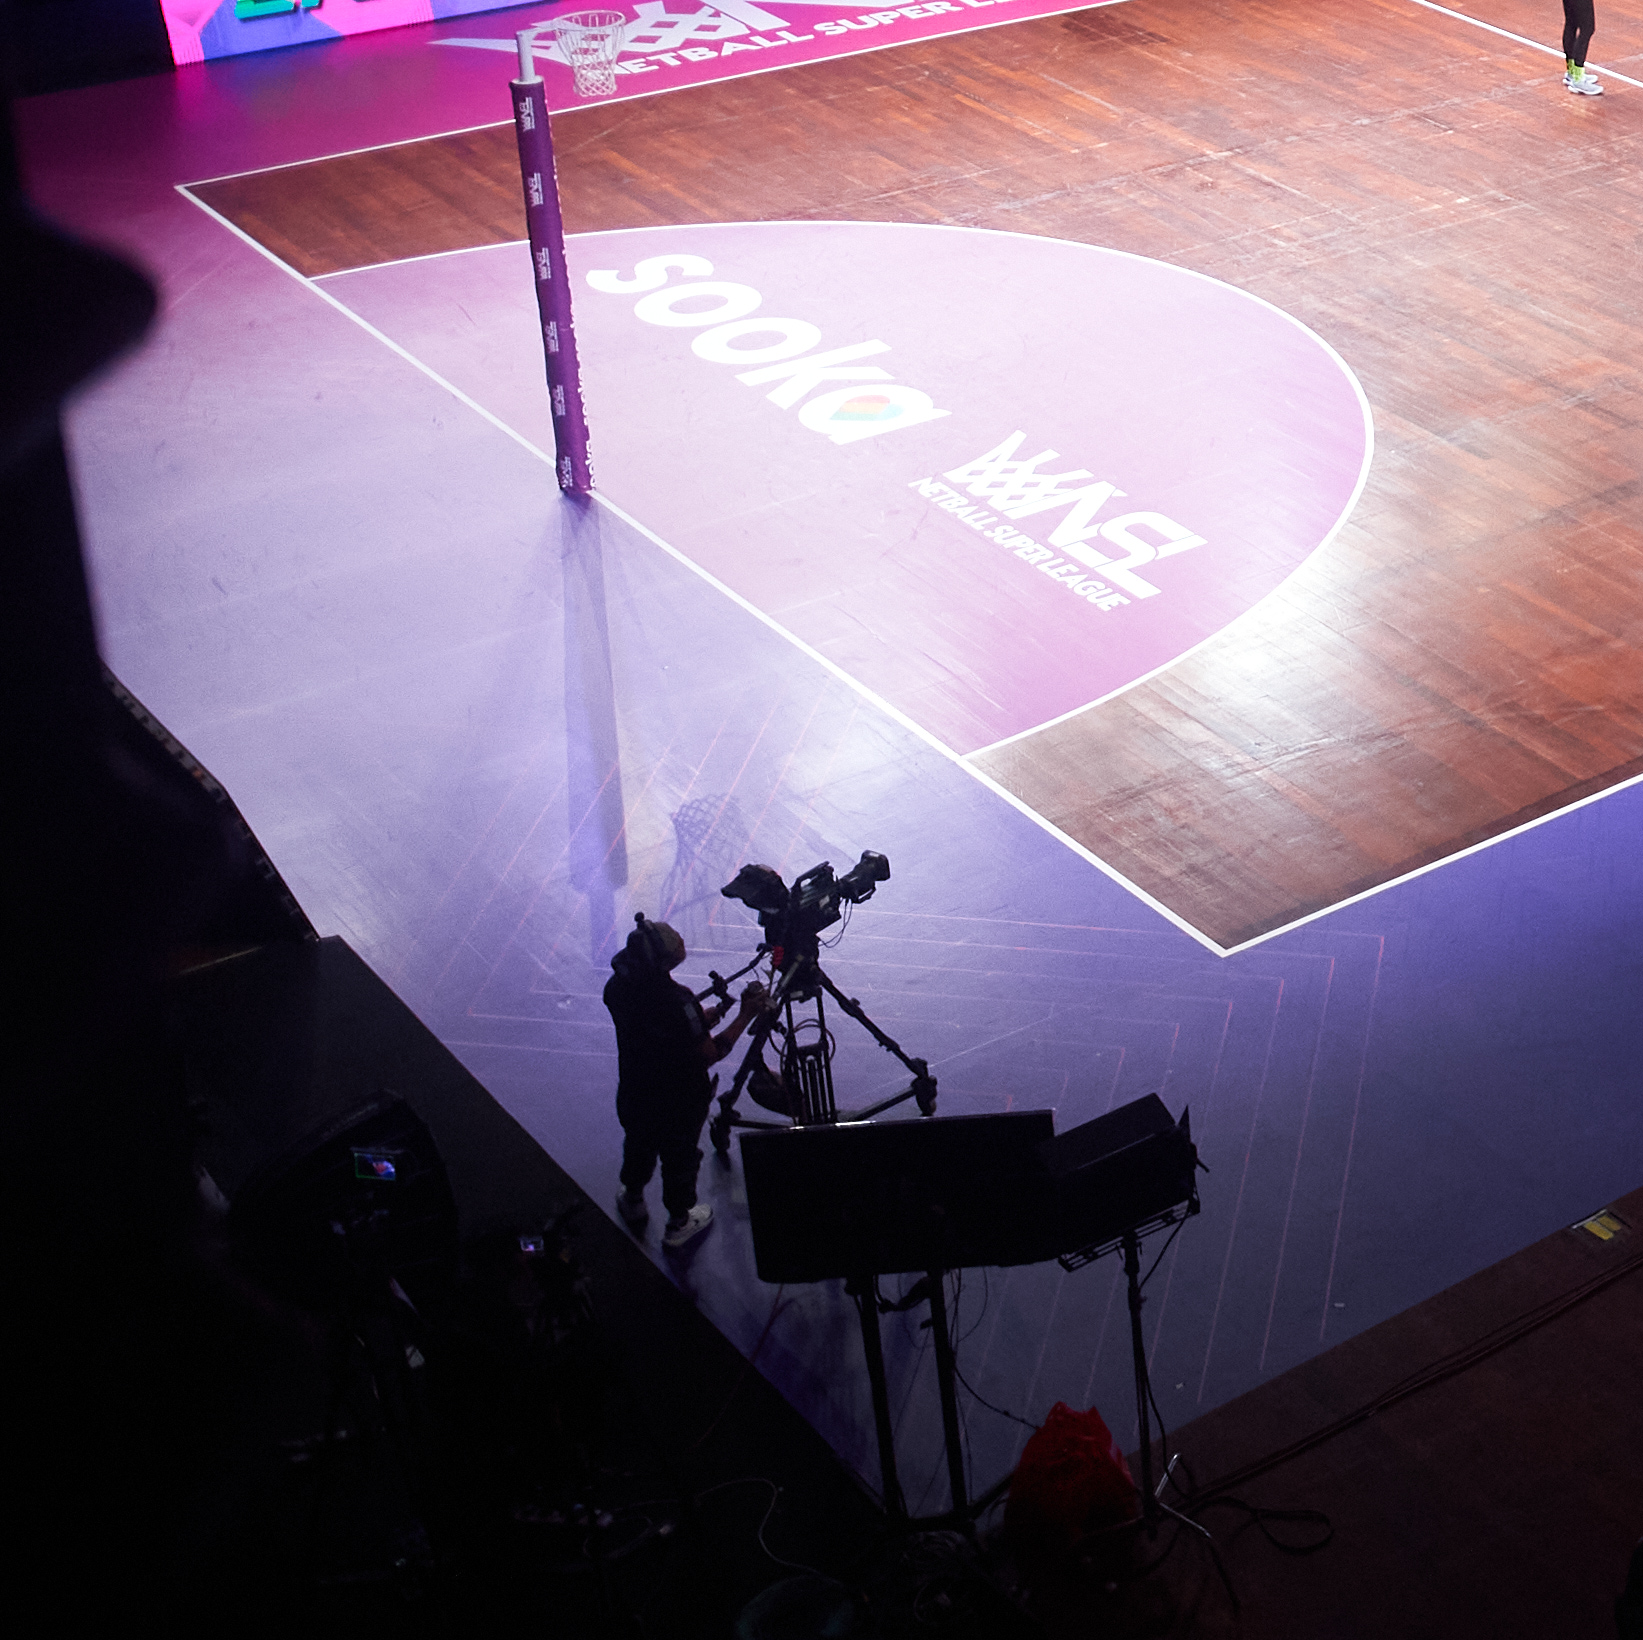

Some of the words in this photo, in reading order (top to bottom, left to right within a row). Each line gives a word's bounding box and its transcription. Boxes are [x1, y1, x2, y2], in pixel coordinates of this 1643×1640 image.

[813, 0, 963, 37] SUPER
[585, 254, 953, 446] sooka
[907, 476, 998, 531] NETBALL
[983, 524, 1054, 566] SUPER
[1035, 557, 1132, 612] LEAGUE
